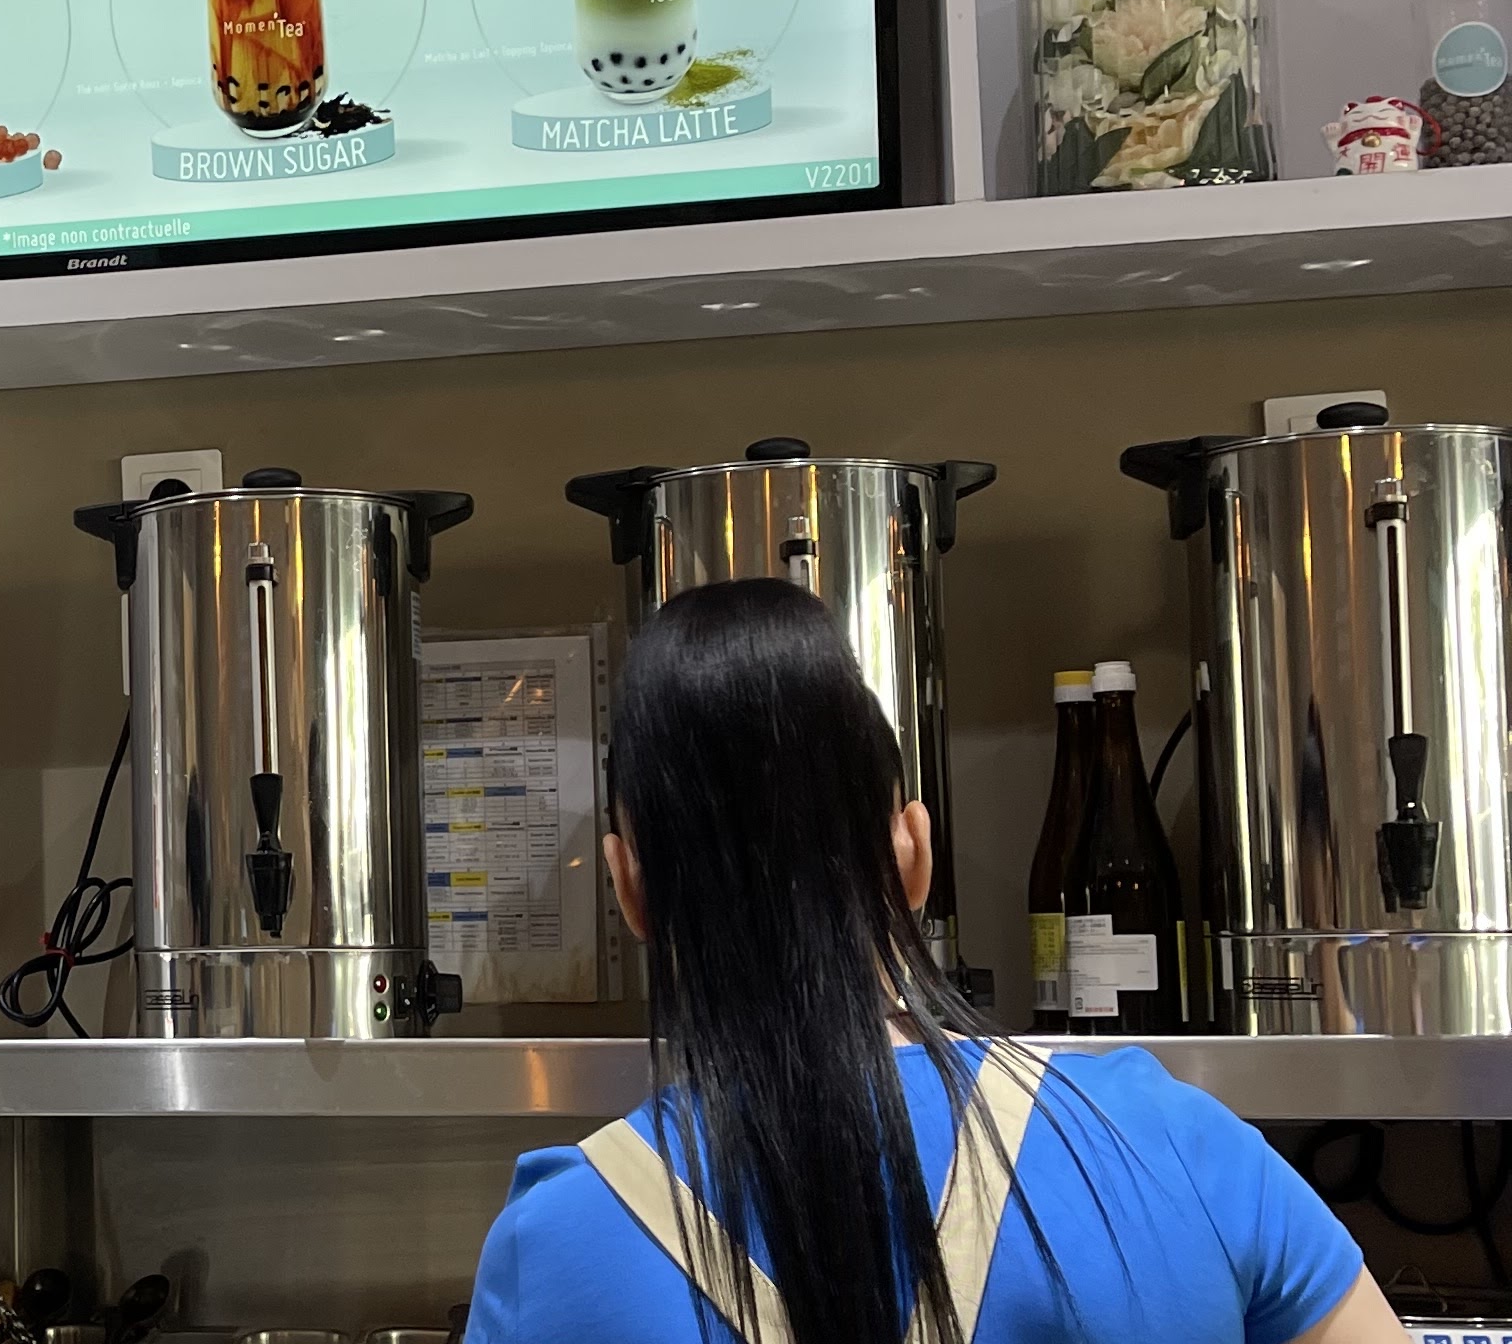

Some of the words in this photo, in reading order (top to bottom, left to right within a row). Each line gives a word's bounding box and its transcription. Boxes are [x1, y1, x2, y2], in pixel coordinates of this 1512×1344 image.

[541, 115, 650, 151] MATCHA
[659, 105, 740, 142] LATTE
[179, 145, 274, 180] BROWN
[284, 137, 368, 175] SUGAR
[804, 162, 873, 189] V2201
[61, 231, 88, 245] non
[93, 218, 191, 243] contractuelle
[67, 254, 128, 271] Brandt
